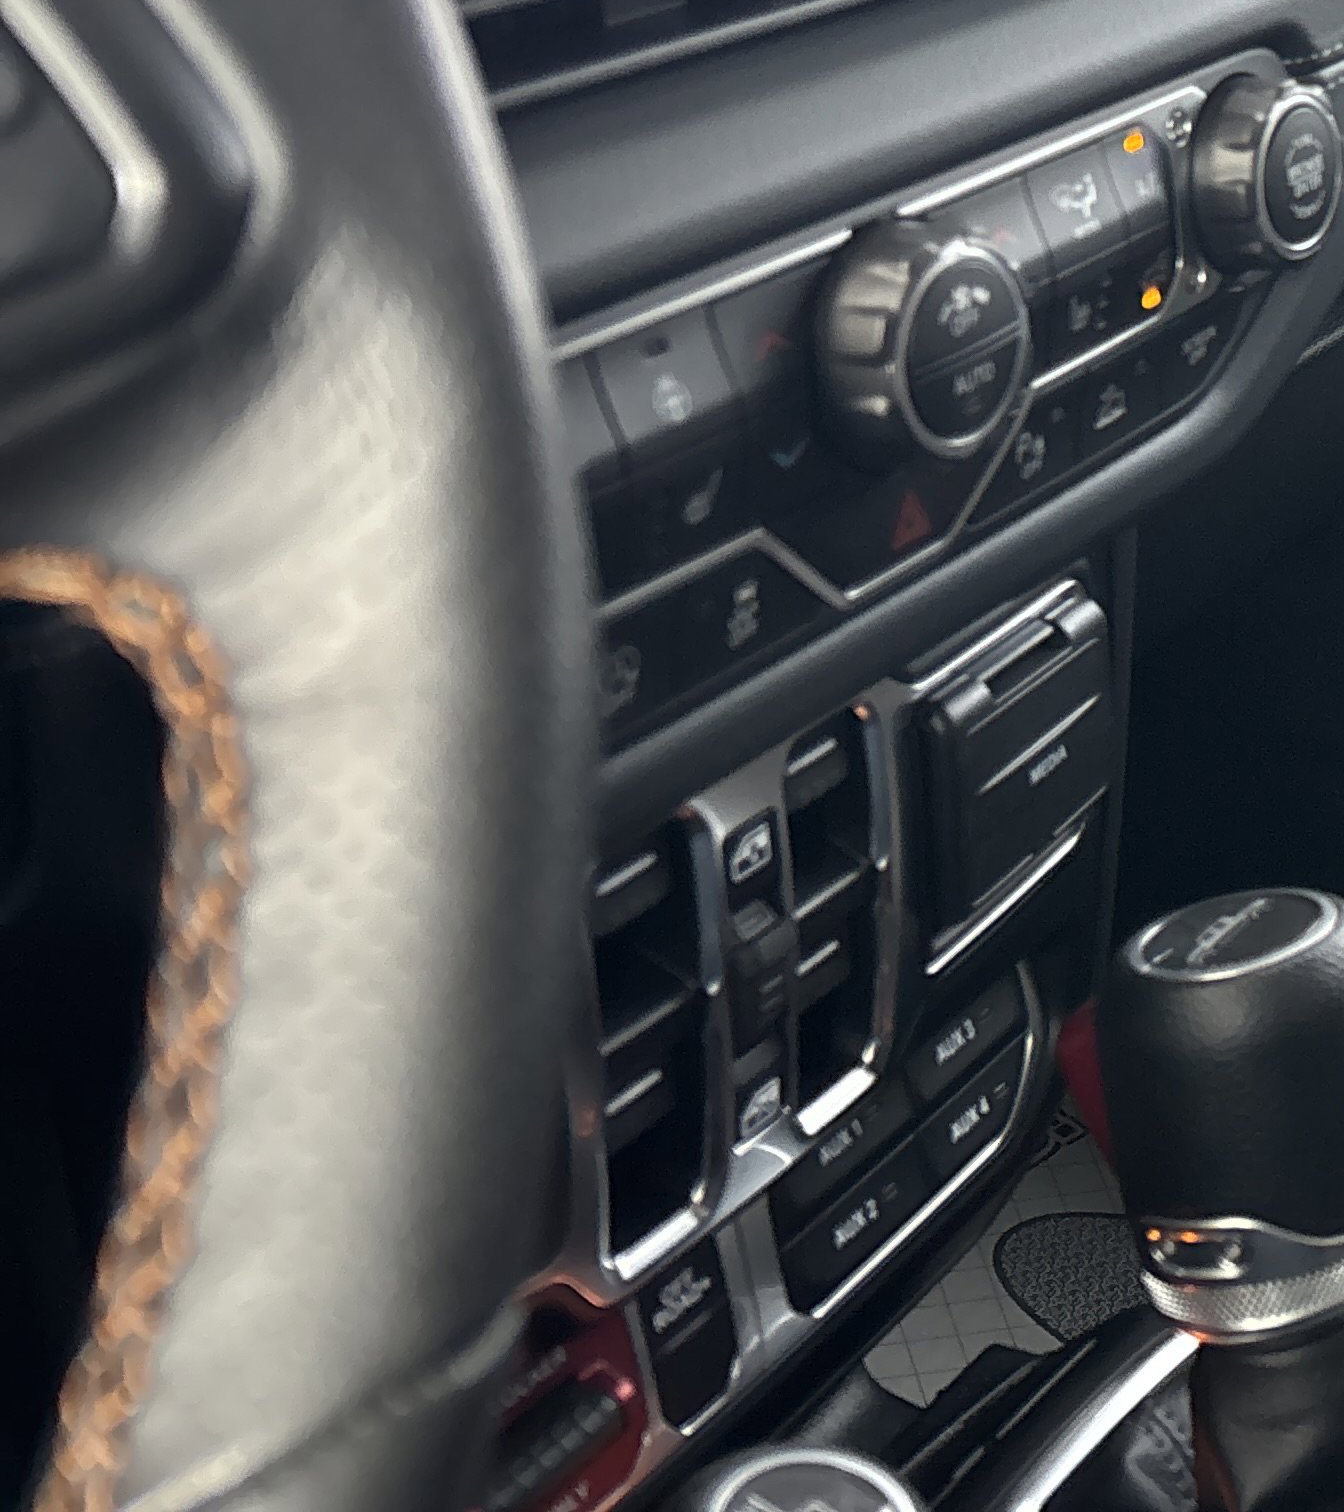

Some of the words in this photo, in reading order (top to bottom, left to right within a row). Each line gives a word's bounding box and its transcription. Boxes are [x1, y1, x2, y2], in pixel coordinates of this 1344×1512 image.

[935, 1027, 967, 1066] AUX
[963, 1017, 976, 1040] 3
[818, 1129, 852, 1167] AUX
[851, 1117, 864, 1137] 1
[950, 1103, 981, 1144] AUX
[832, 1207, 867, 1250] AUX
[864, 1197, 879, 1221] 2
